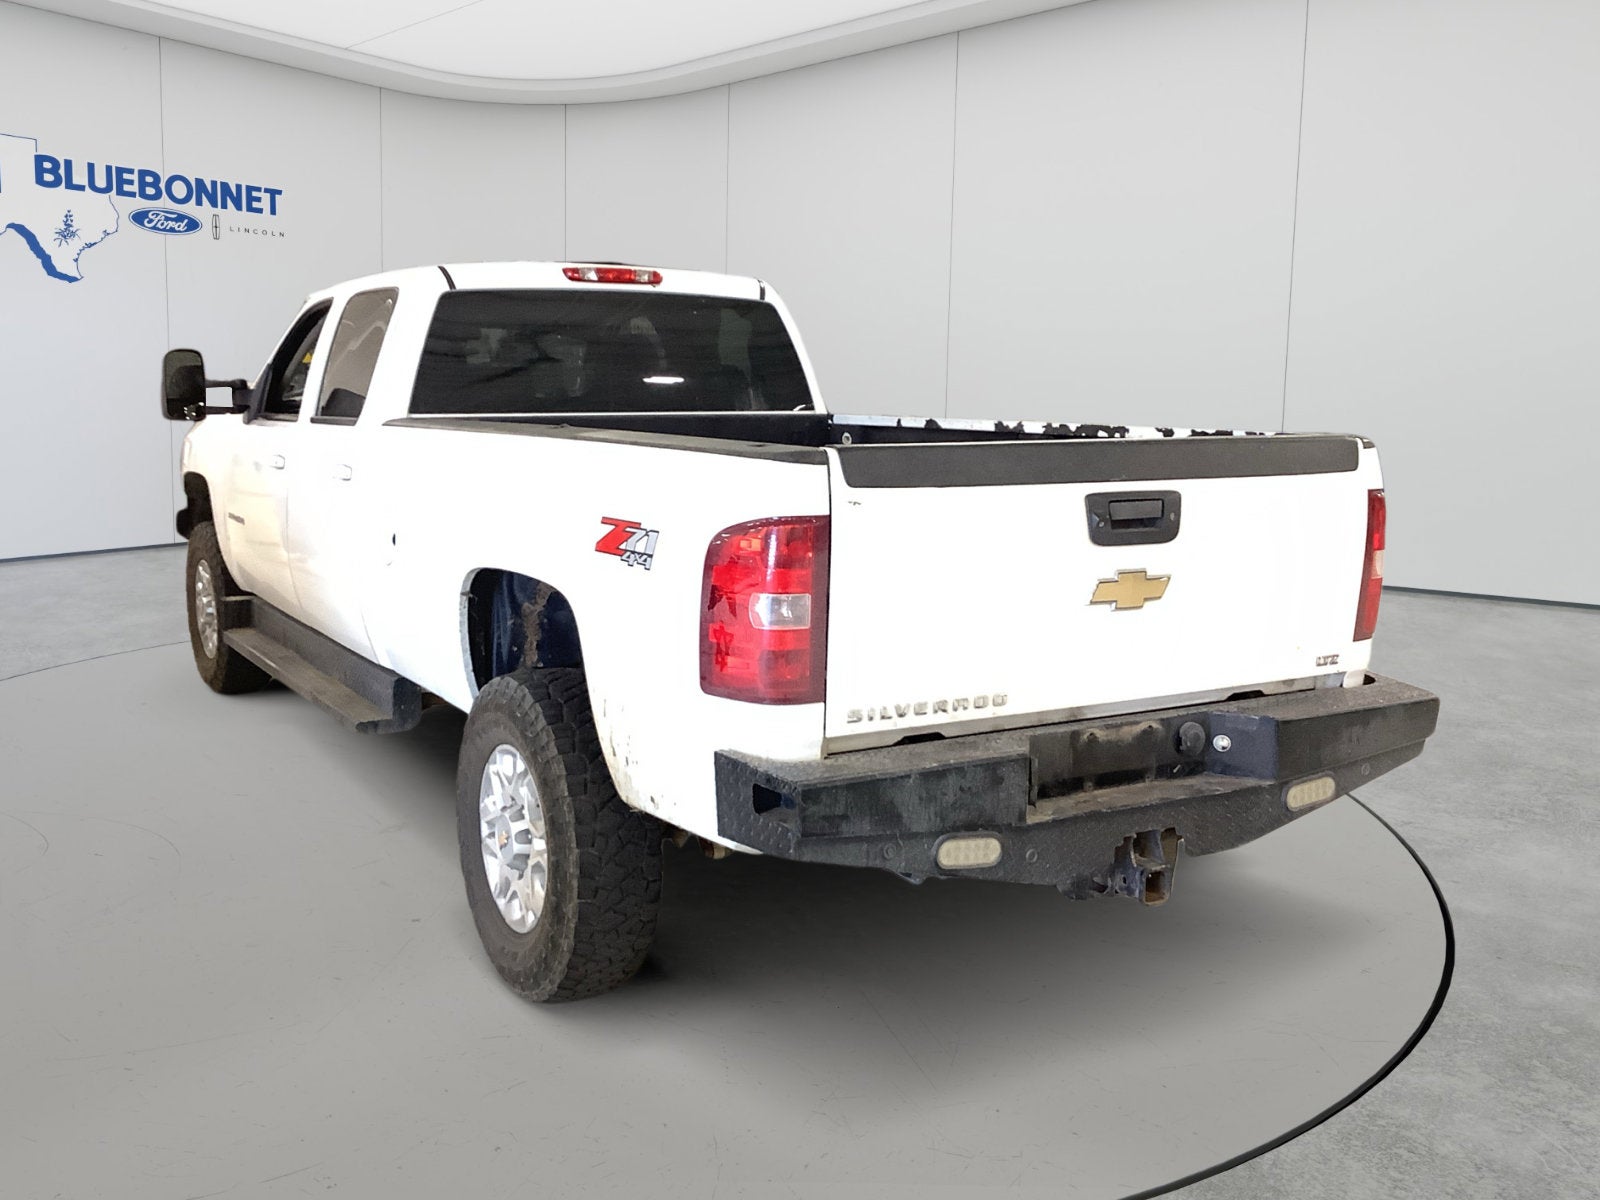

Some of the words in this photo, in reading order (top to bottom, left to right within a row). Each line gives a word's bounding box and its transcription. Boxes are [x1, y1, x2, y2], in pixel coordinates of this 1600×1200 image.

[34, 154, 282, 216] BLUEBONNET
[143, 210, 187, 232] Ford
[229, 225, 285, 238] LINCOLN
[595, 516, 659, 558] Z71
[847, 694, 1008, 724] SILVERADO
